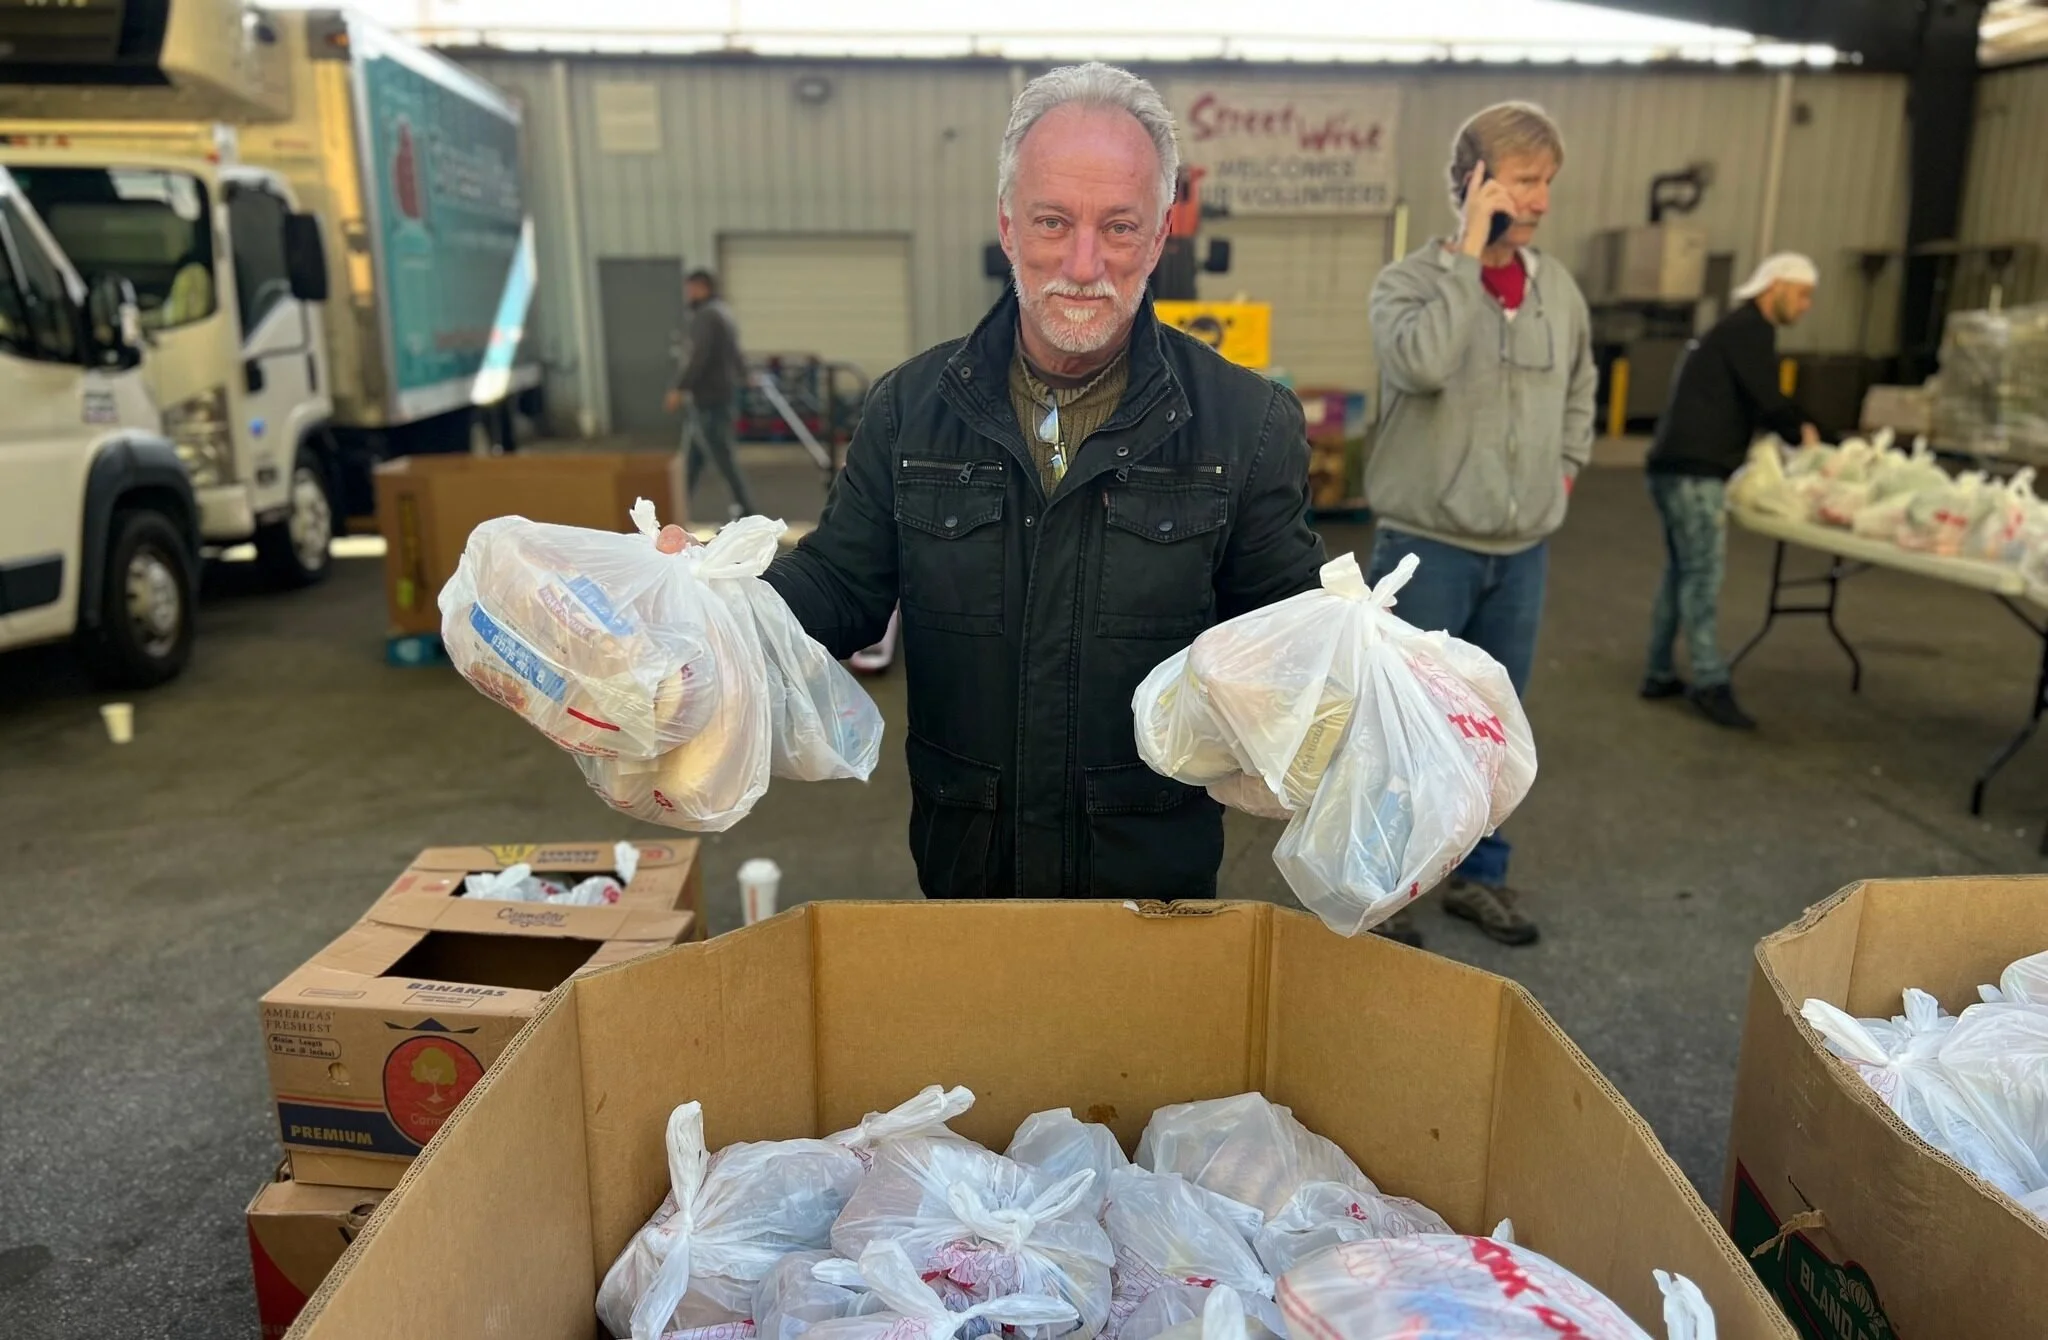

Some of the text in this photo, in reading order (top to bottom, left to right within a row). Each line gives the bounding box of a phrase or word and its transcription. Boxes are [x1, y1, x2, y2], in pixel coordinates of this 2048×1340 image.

[1188, 91, 1295, 143] Street
[406, 982, 508, 997] BANANAS
[265, 1019, 333, 1033] FRESHEST
[290, 1125, 374, 1146] PREMIUM
